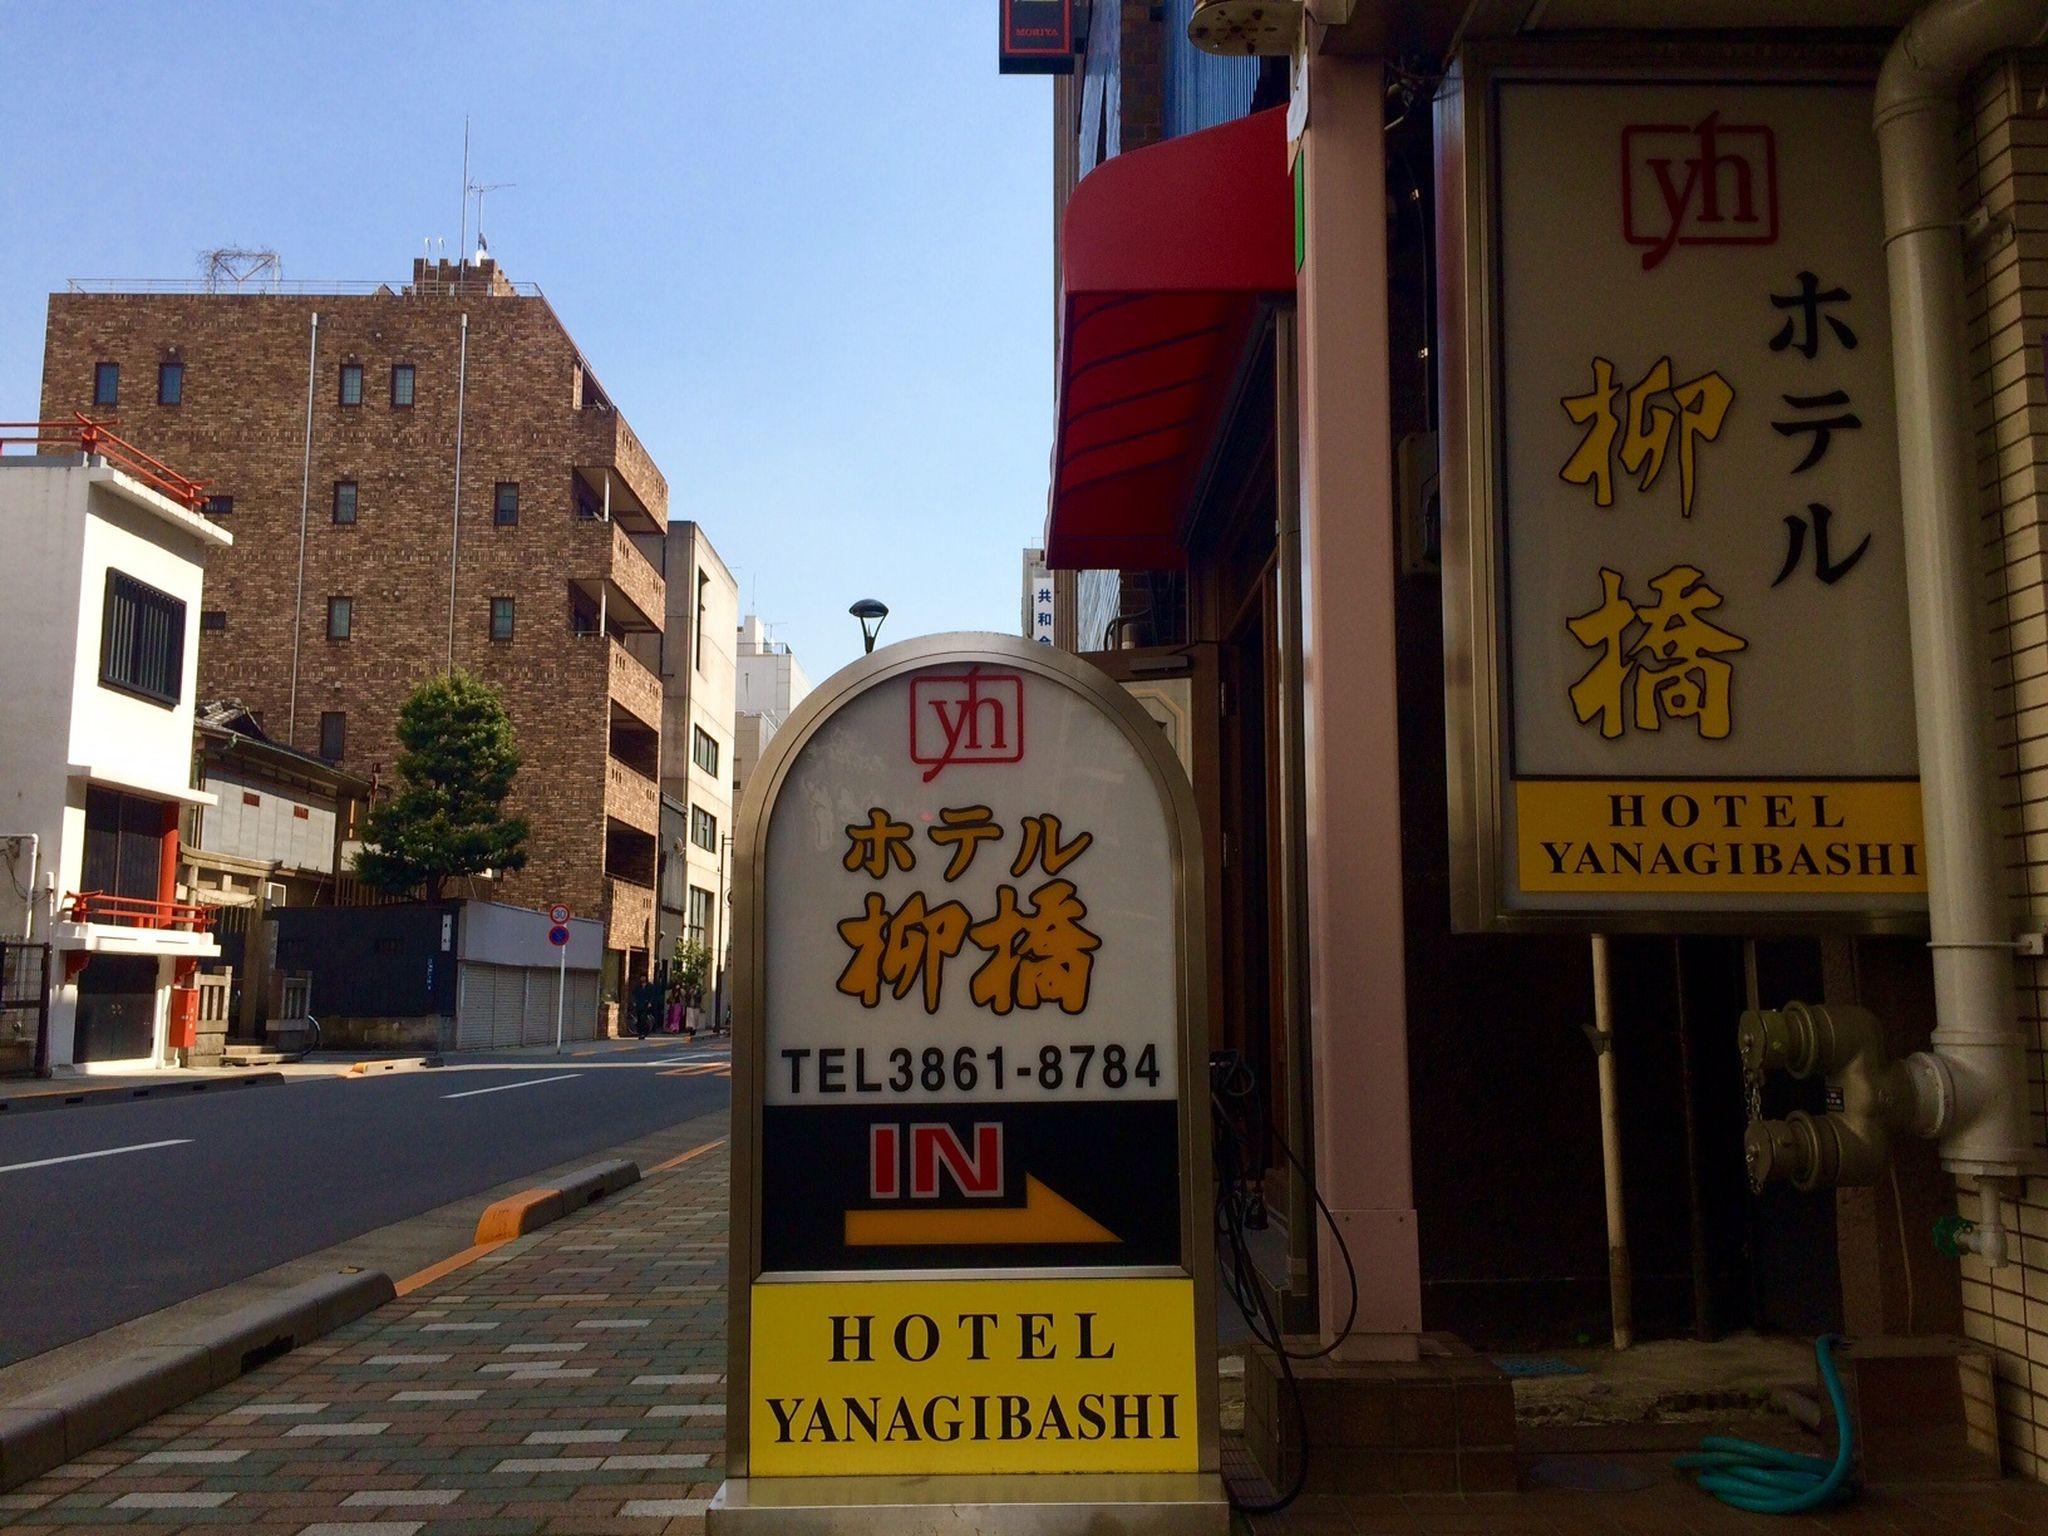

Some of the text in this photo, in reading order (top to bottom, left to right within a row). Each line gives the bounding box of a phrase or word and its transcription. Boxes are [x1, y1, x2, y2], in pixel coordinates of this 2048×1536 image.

[1642, 110, 1758, 271] yh
[1769, 271, 1872, 588] ホテル
[1558, 356, 1749, 739] 柳橋
[922, 666, 1008, 782] yh
[843, 805, 1093, 882] ホテル
[1608, 794, 1845, 828] HOTEL
[1540, 842, 1920, 876] YANAGIBASHI
[837, 878, 1102, 1015] 柳橋
[869, 1121, 1004, 1199] IN
[828, 1312, 1116, 1362] HOTEL
[766, 1393, 1181, 1443] YANAGIBASHI
